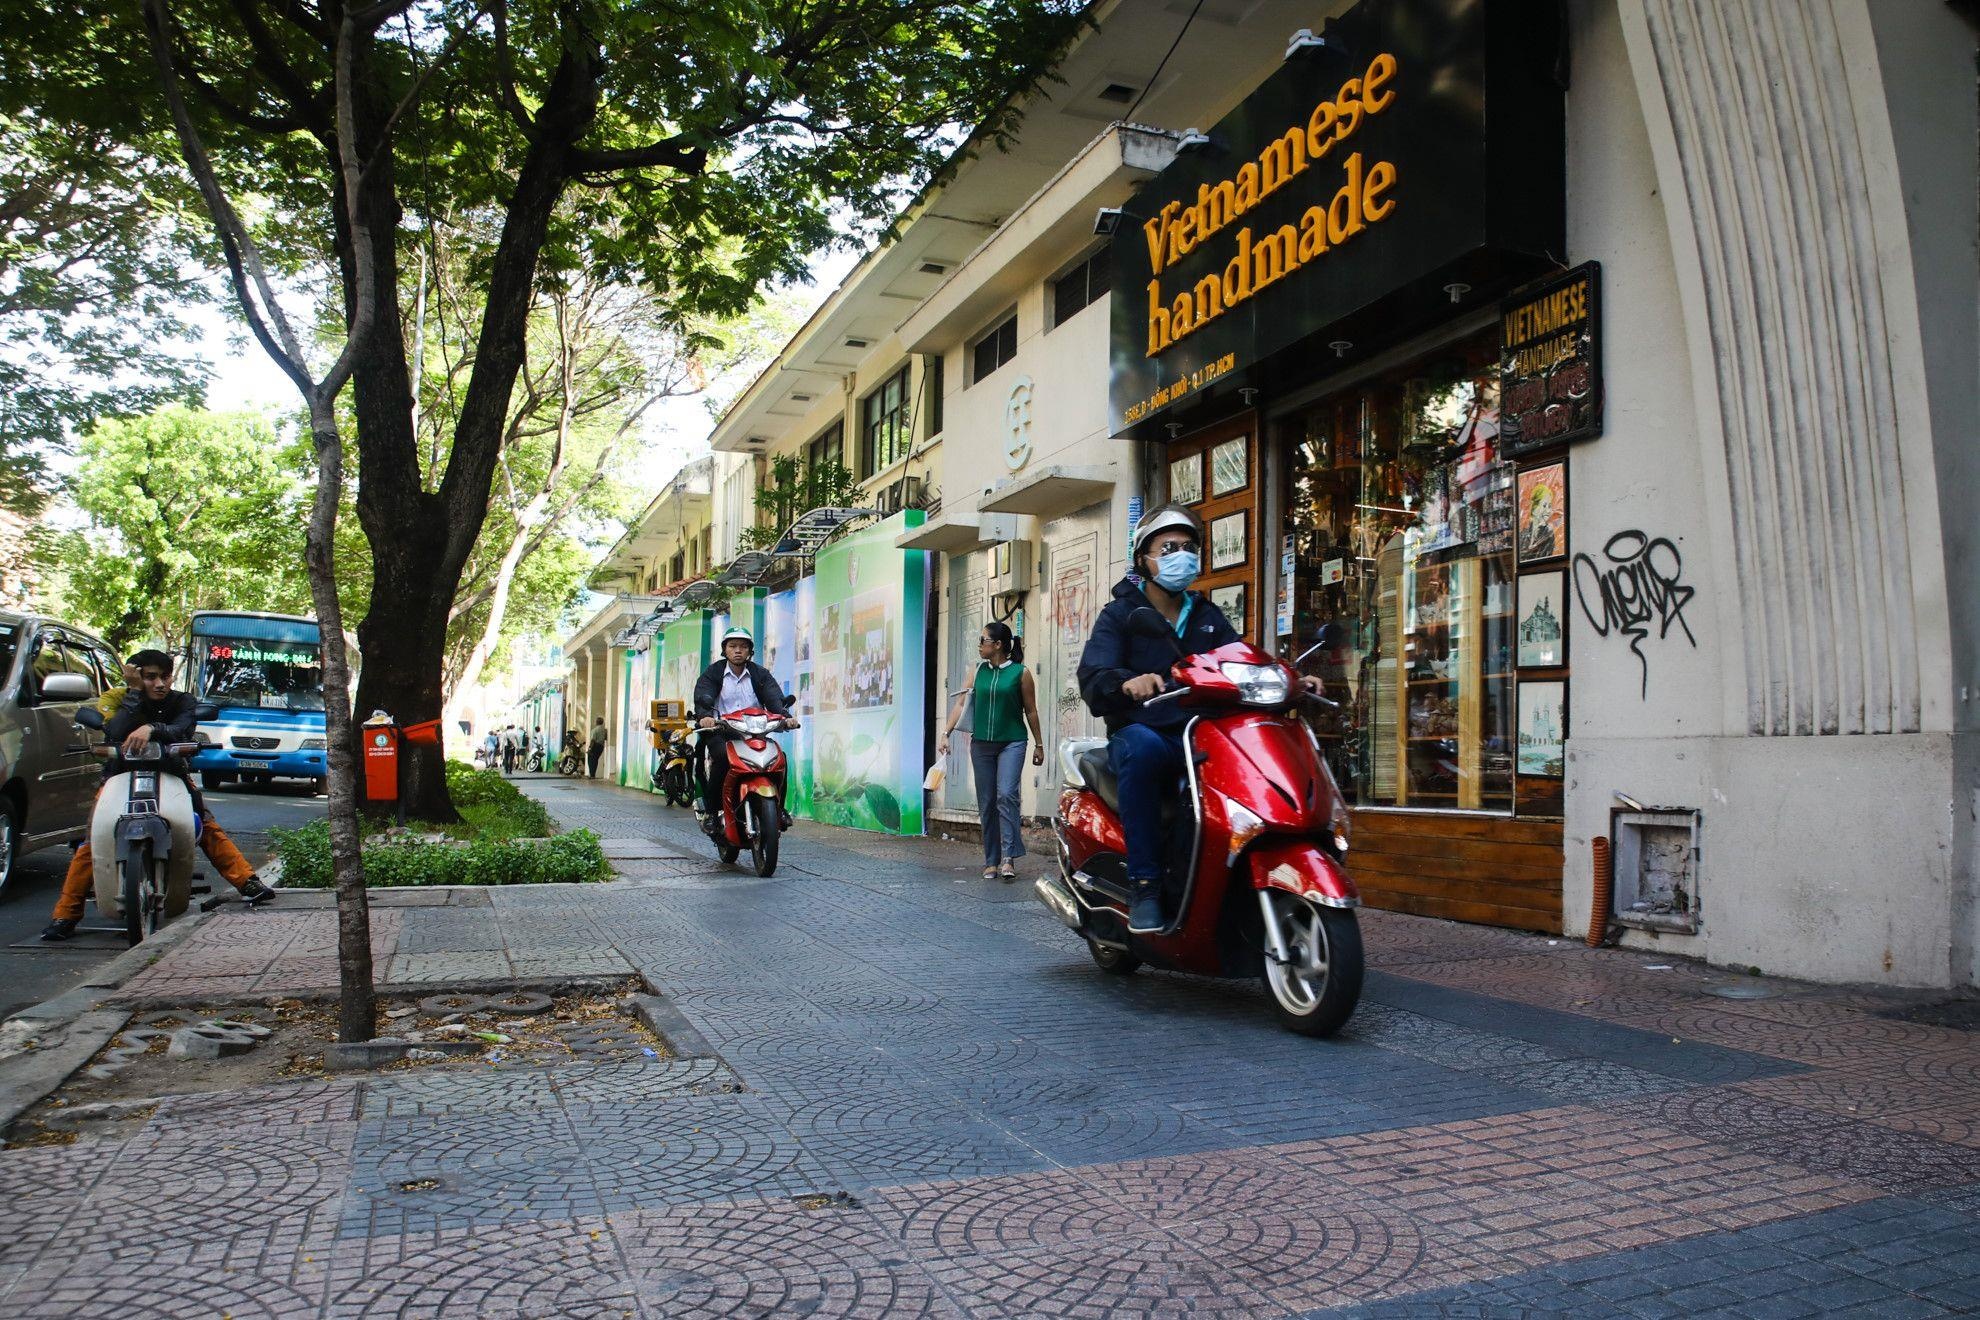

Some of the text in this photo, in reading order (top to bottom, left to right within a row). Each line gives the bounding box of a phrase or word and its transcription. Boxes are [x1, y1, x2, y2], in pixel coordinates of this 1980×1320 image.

[1143, 53, 1397, 275] Vietnamese
[1146, 152, 1397, 358] handmade
[1505, 280, 1587, 348] VIETNAMESE
[1515, 331, 1577, 378] HANDMADE
